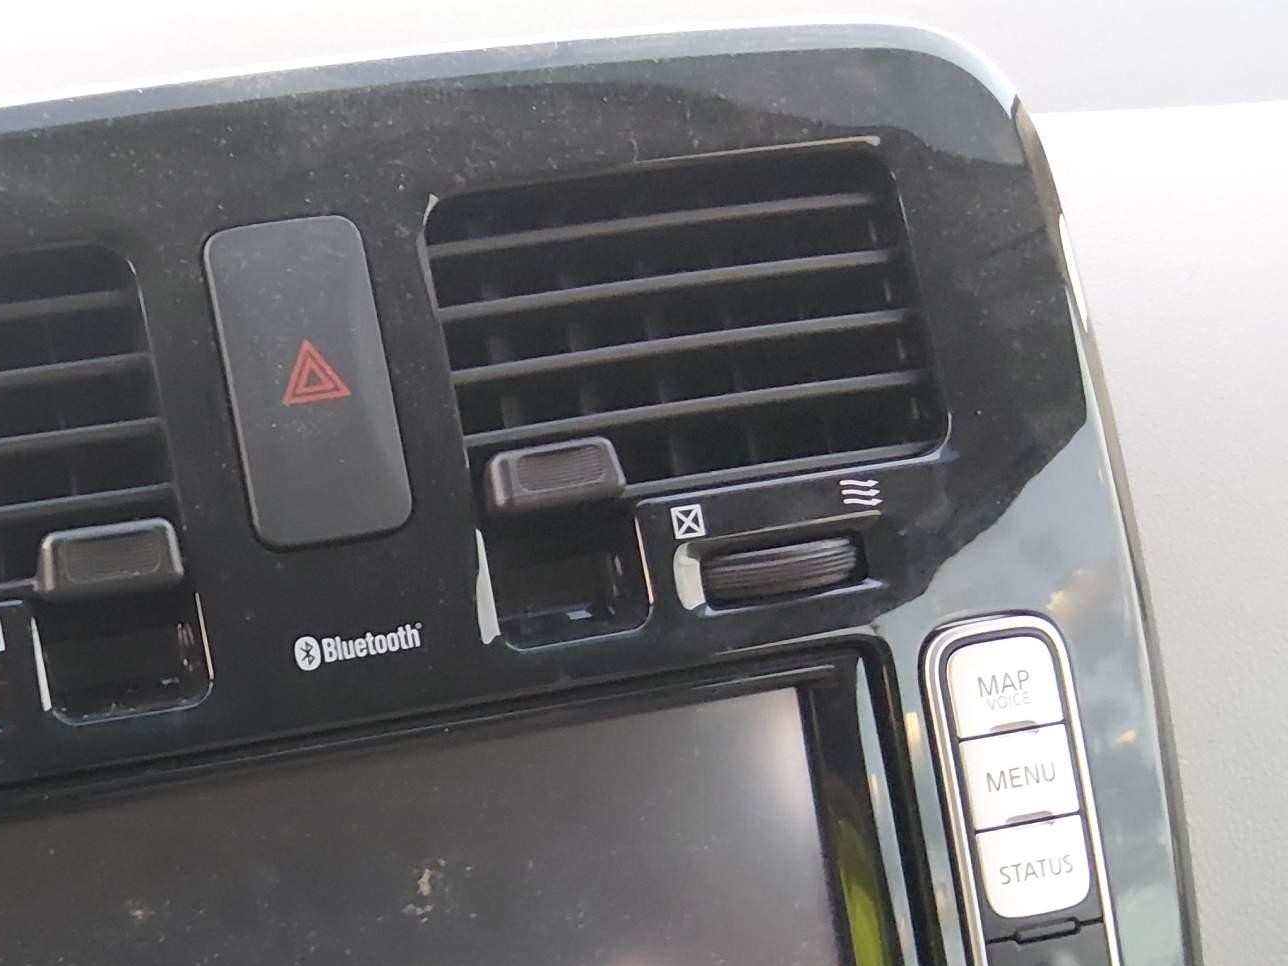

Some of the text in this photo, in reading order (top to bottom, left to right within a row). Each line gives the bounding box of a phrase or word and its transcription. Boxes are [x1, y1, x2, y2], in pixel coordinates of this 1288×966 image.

[322, 622, 422, 663] Bluetooth
[977, 669, 1030, 698] MAP
[985, 691, 1033, 711] VOICE
[986, 762, 1056, 793] MENU
[999, 854, 1074, 885] STATUS
